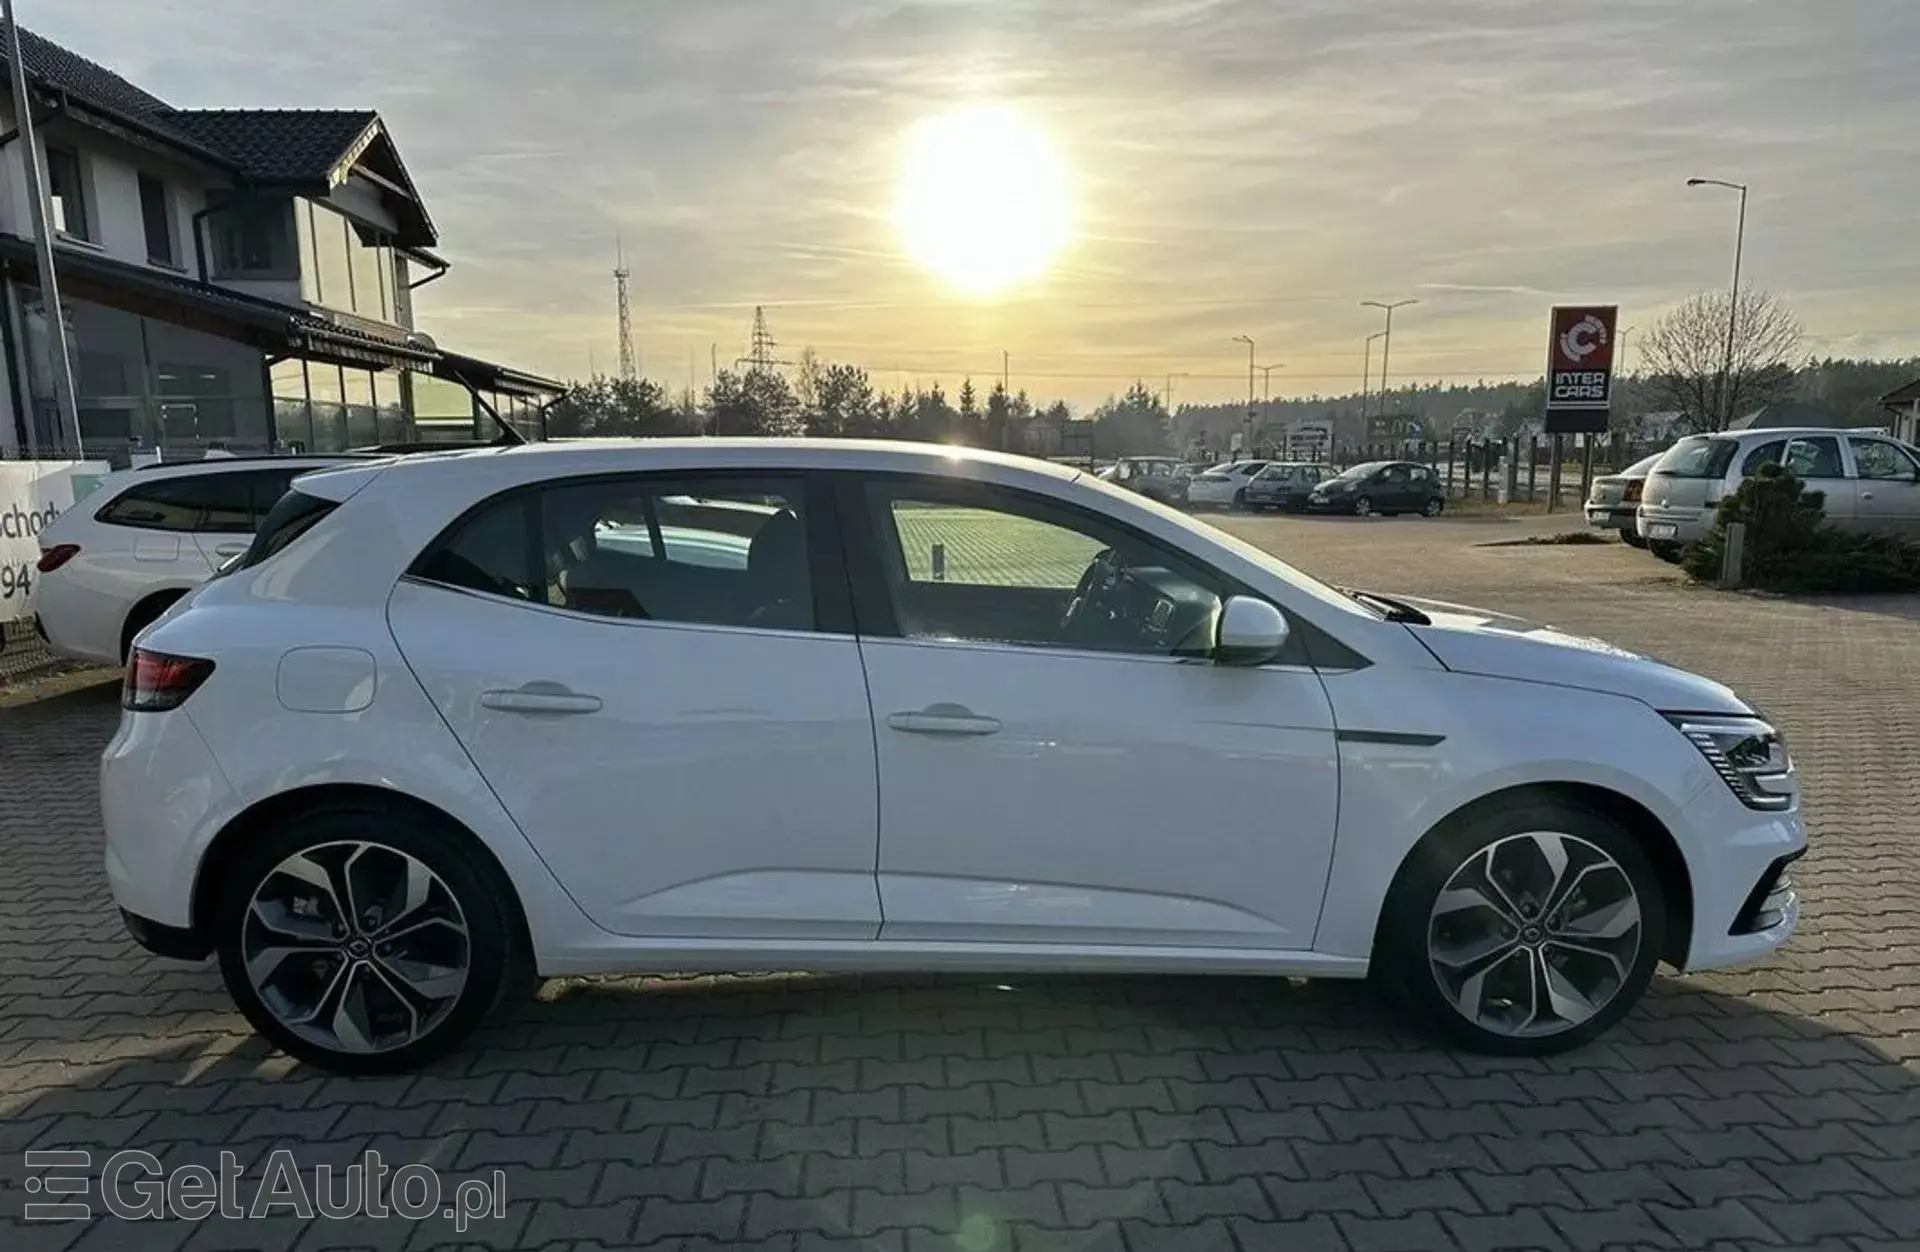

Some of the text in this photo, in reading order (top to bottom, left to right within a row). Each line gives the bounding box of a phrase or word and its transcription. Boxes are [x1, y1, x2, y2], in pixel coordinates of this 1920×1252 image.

[1555, 372, 1606, 385] INTER
[1555, 385, 1604, 398] CARS
[2, 564, 31, 599] 94
